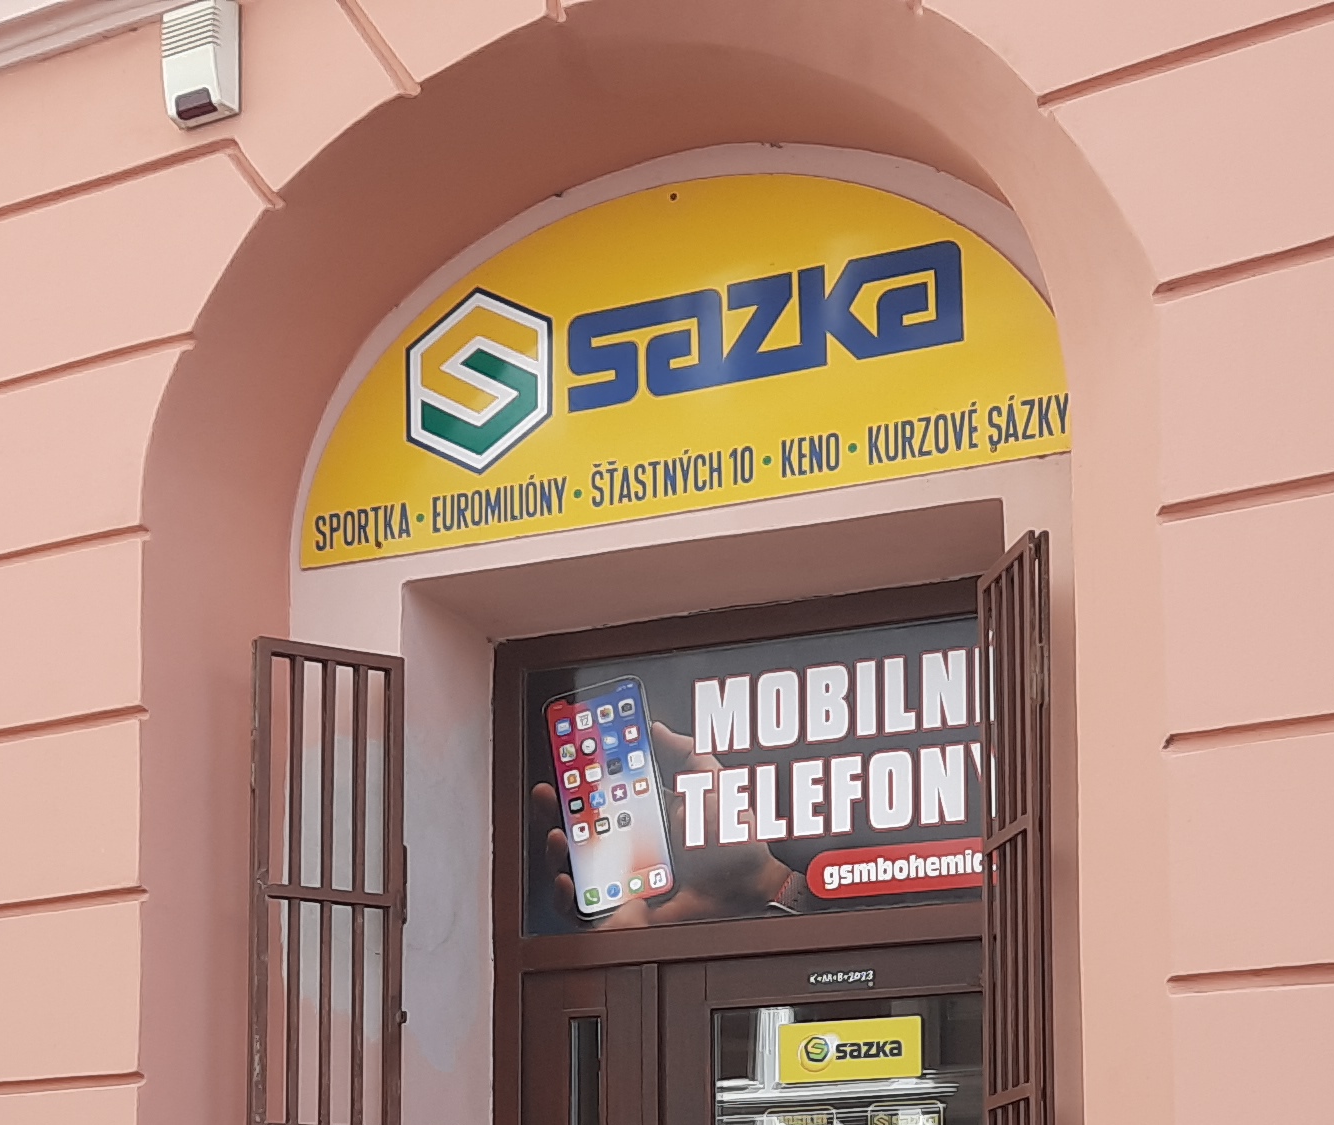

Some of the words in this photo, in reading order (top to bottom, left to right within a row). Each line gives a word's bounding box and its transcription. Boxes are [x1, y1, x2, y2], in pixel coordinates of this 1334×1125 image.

[314, 502, 412, 552] SPORTKA
[432, 474, 567, 534] EUROMILIÓNY
[590, 448, 723, 508] ŠŤASTNÝCH
[729, 445, 754, 487] 10
[781, 432, 840, 478] KENO
[867, 401, 979, 465] KURZOVÉ
[987, 393, 1069, 452] SÁZKY
